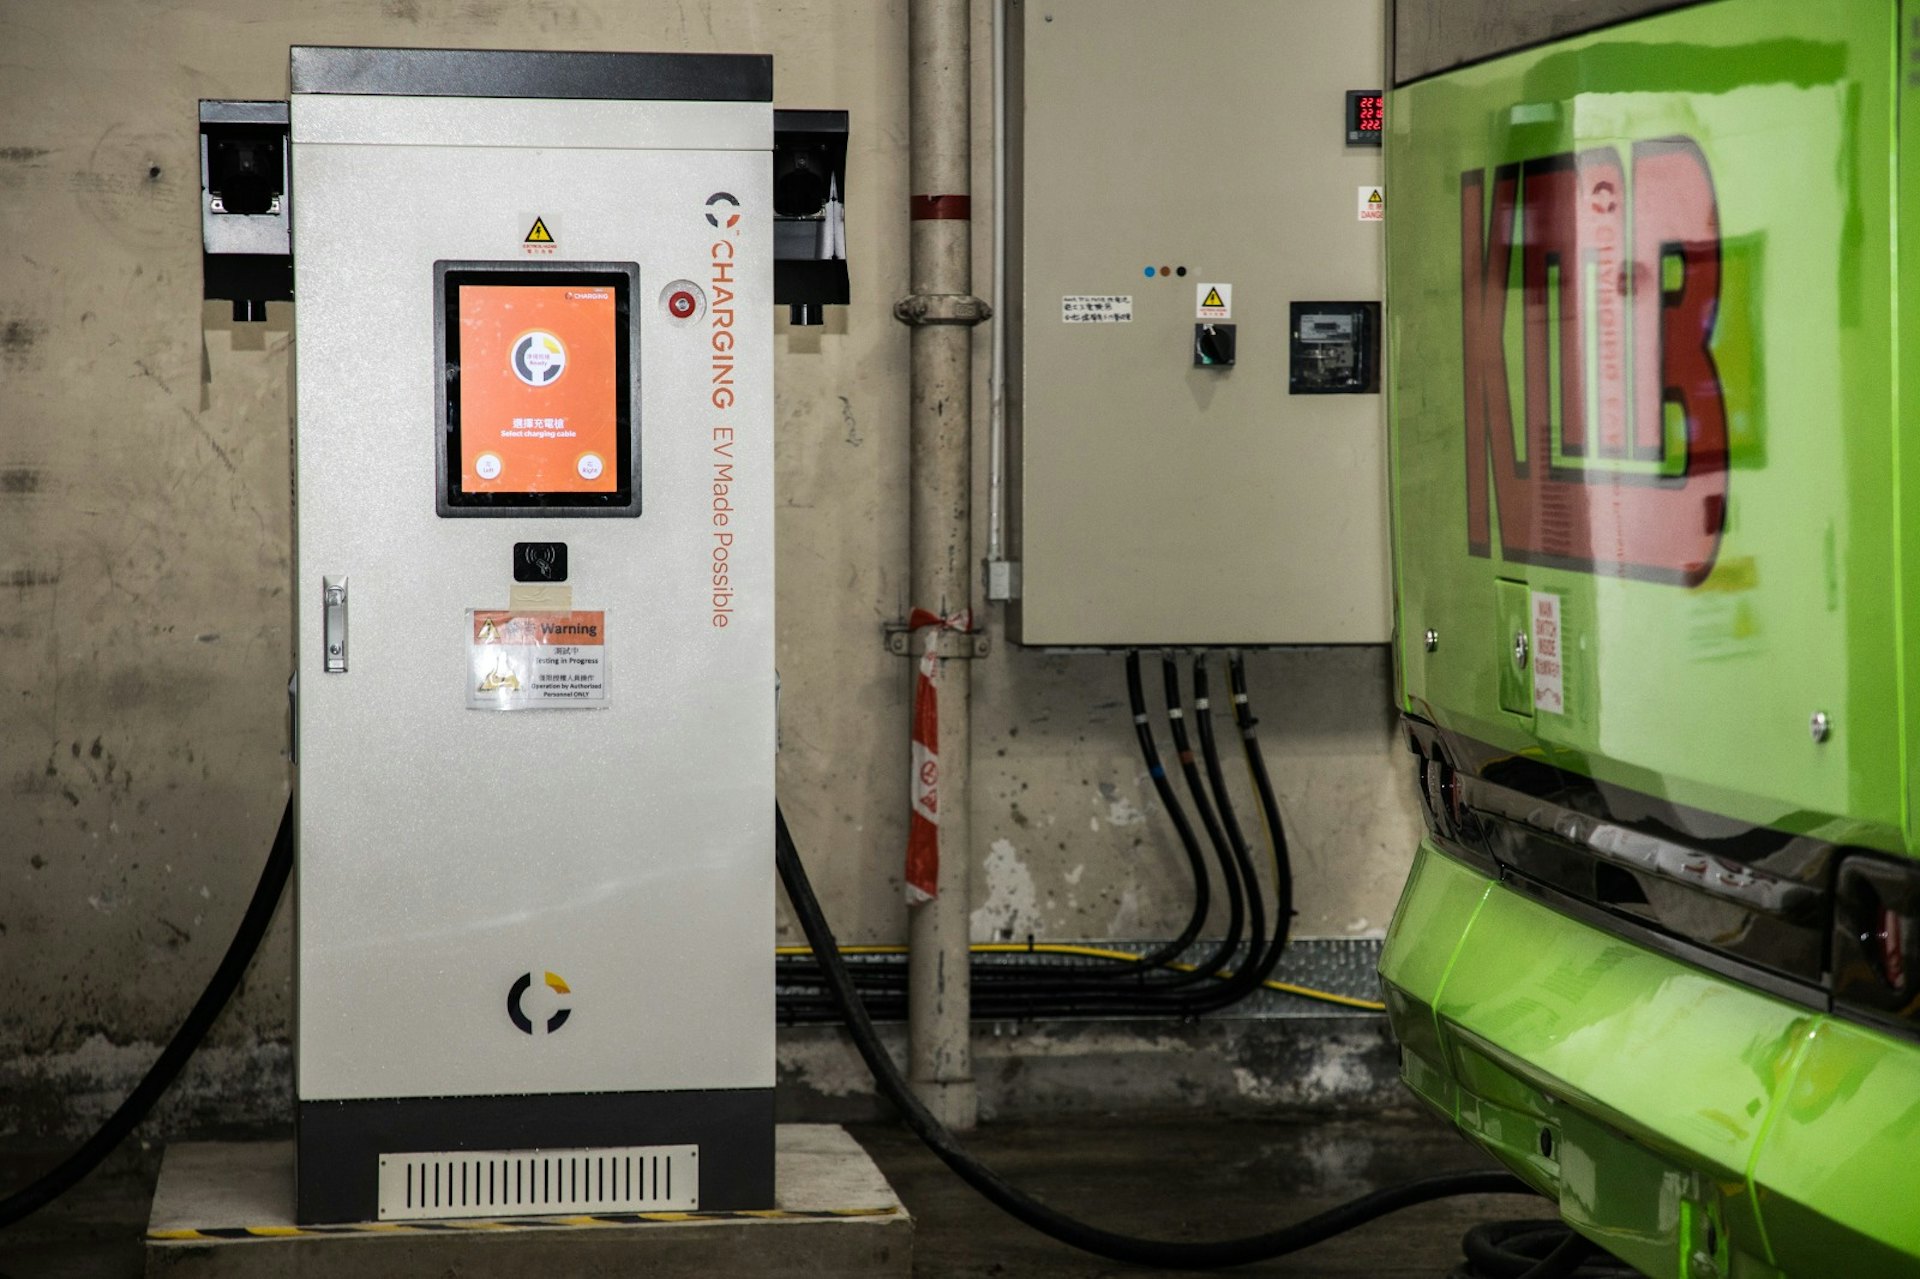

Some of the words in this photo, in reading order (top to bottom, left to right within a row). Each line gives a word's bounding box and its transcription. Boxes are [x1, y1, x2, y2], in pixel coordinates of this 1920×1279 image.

[711, 239, 734, 409] CHARGING
[524, 430, 556, 438] charging
[713, 427, 734, 458] EV
[712, 463, 734, 526] Made
[712, 533, 734, 628] Possible
[541, 623, 597, 637] Warning
